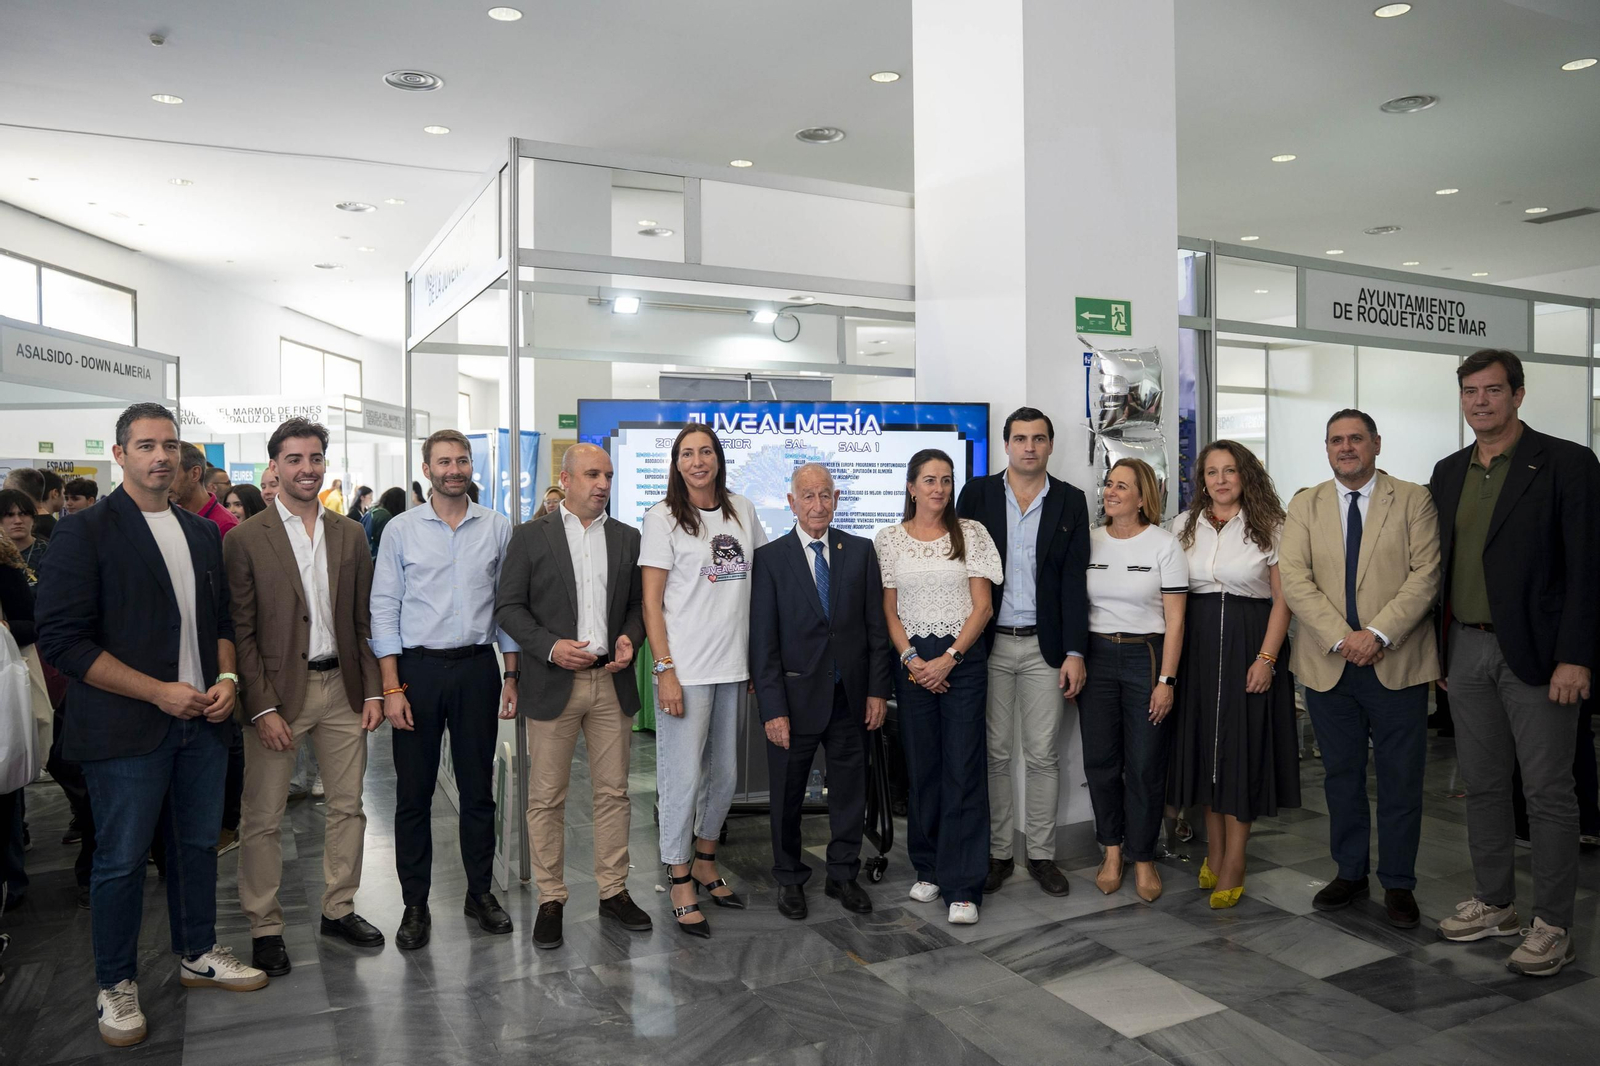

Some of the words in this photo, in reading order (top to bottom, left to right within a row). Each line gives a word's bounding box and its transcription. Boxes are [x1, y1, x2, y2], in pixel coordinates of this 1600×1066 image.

[1358, 287, 1465, 318] AYUNTAMIENTO
[1333, 302, 1353, 321] DE
[1357, 305, 1434, 331] ROQUETAS
[1438, 316, 1455, 333] DE
[1459, 318, 1487, 337] MAR
[16, 343, 73, 366] ASALSIDO
[81, 355, 111, 373] DOWN
[113, 363, 152, 381] ALMERÍA
[233, 406, 275, 416] MARMOL
[277, 406, 291, 415] DE
[293, 405, 322, 414] FINES
[263, 415, 277, 423] DE
[838, 441, 871, 453] SALA
[874, 441, 880, 453] 1
[46, 461, 74, 473] ESPACIO
